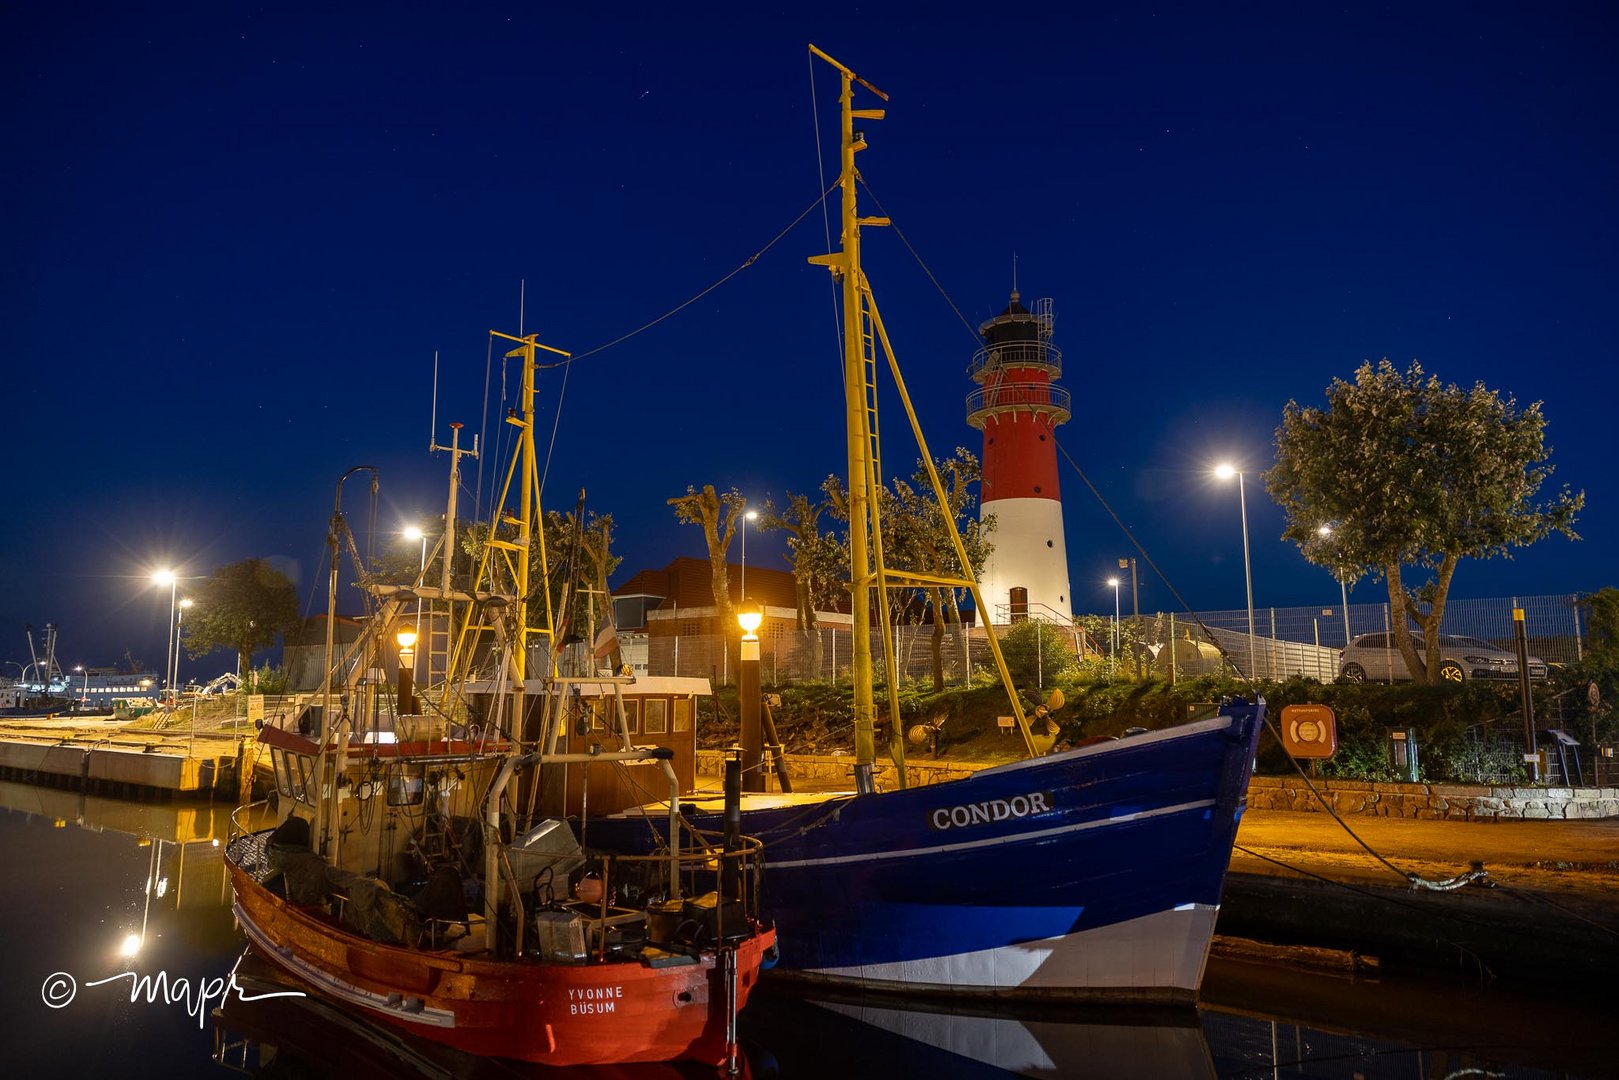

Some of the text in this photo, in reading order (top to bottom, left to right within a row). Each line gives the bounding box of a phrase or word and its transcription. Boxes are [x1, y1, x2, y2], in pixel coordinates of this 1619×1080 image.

[932, 792, 1050, 830] CONDOR
[568, 986, 623, 1000] YVONNE
[570, 1001, 615, 1015] BÜSUM
